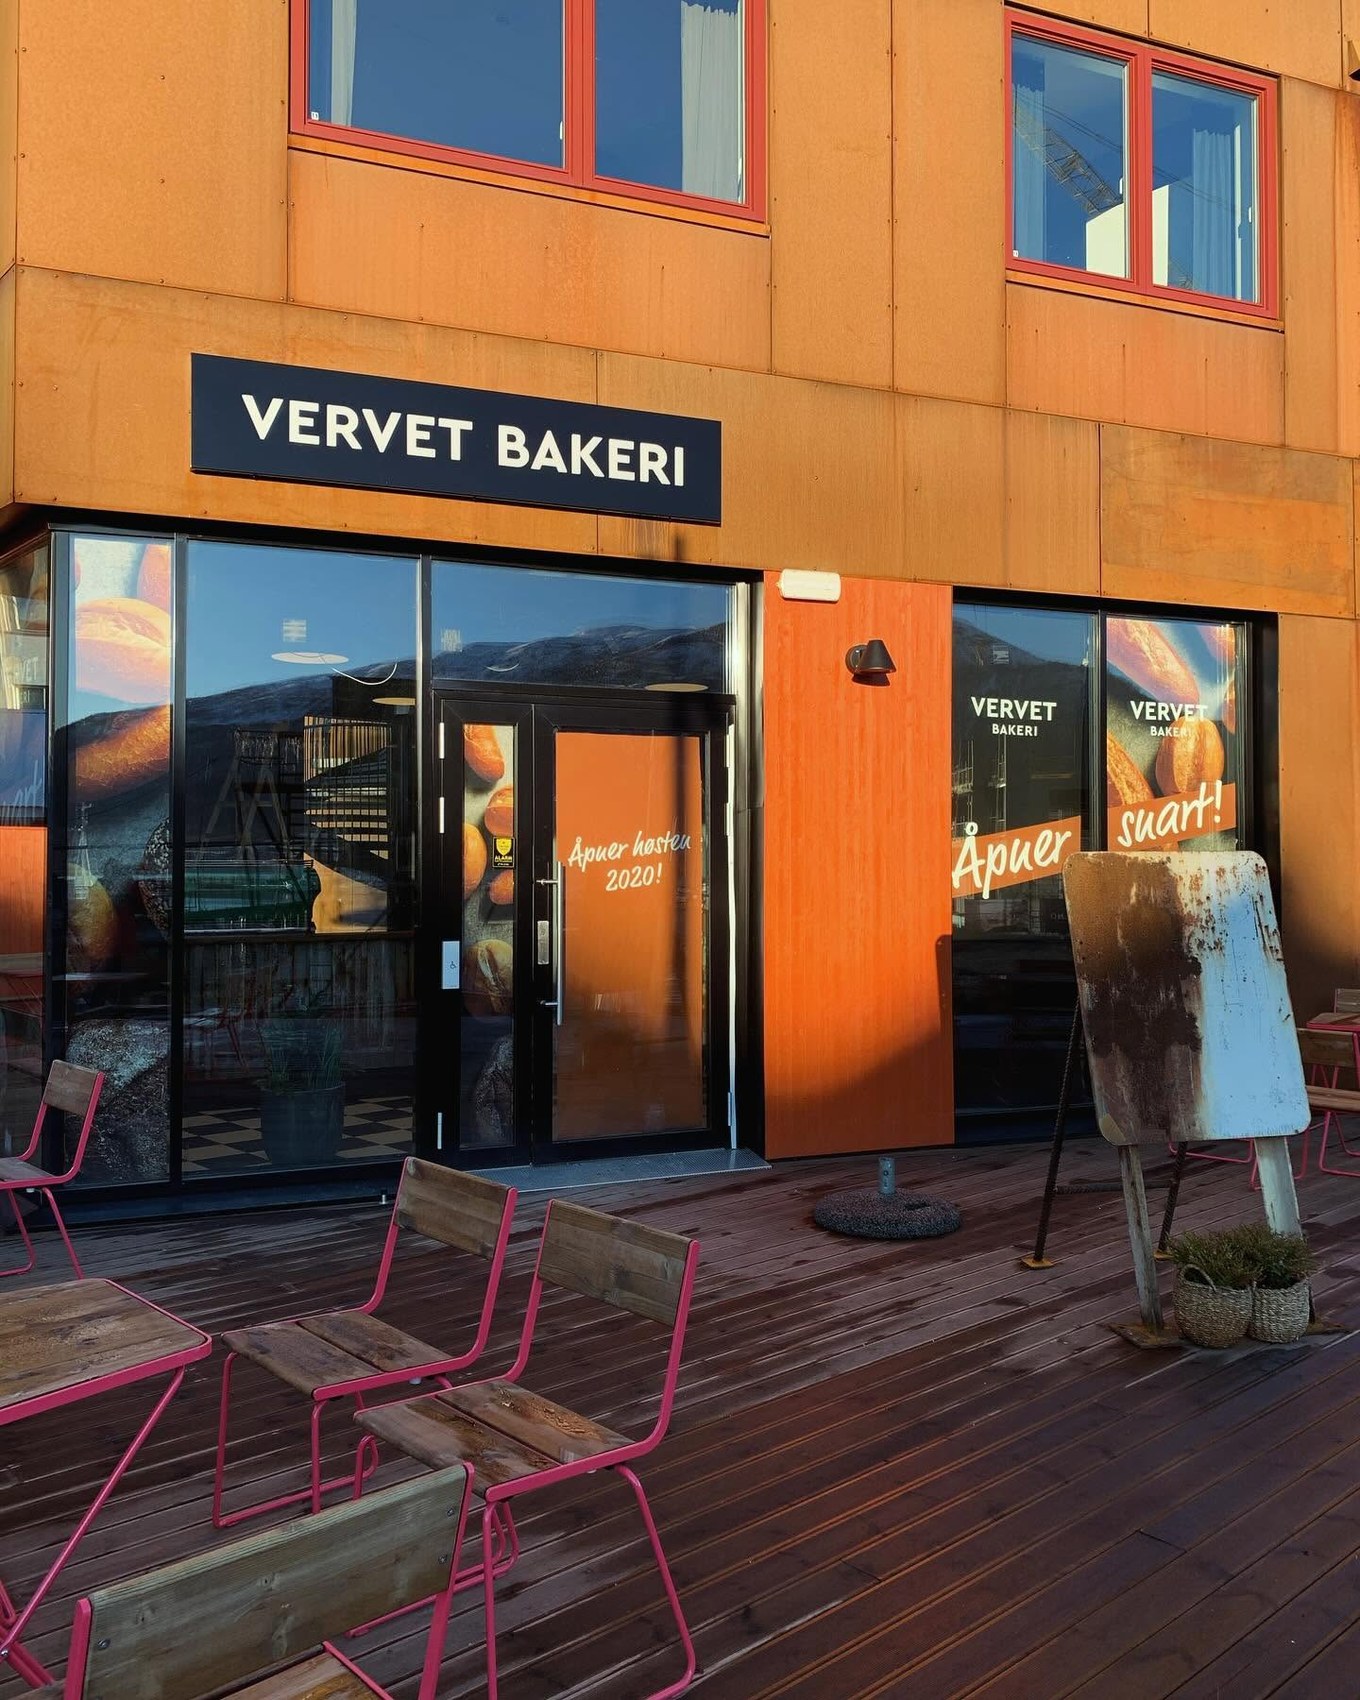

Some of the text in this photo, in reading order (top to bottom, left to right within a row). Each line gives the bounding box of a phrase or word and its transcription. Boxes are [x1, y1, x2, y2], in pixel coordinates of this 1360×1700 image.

[241, 394, 685, 487] VERVET BAKERI
[970, 696, 1057, 721] VERVET
[1129, 700, 1208, 722] VERVET
[992, 724, 1038, 737] BAKERI
[1117, 779, 1222, 848] snart!
[568, 830, 691, 872] Åpner høsten
[952, 821, 1072, 899] Åpner
[605, 862, 663, 891] 2020!
